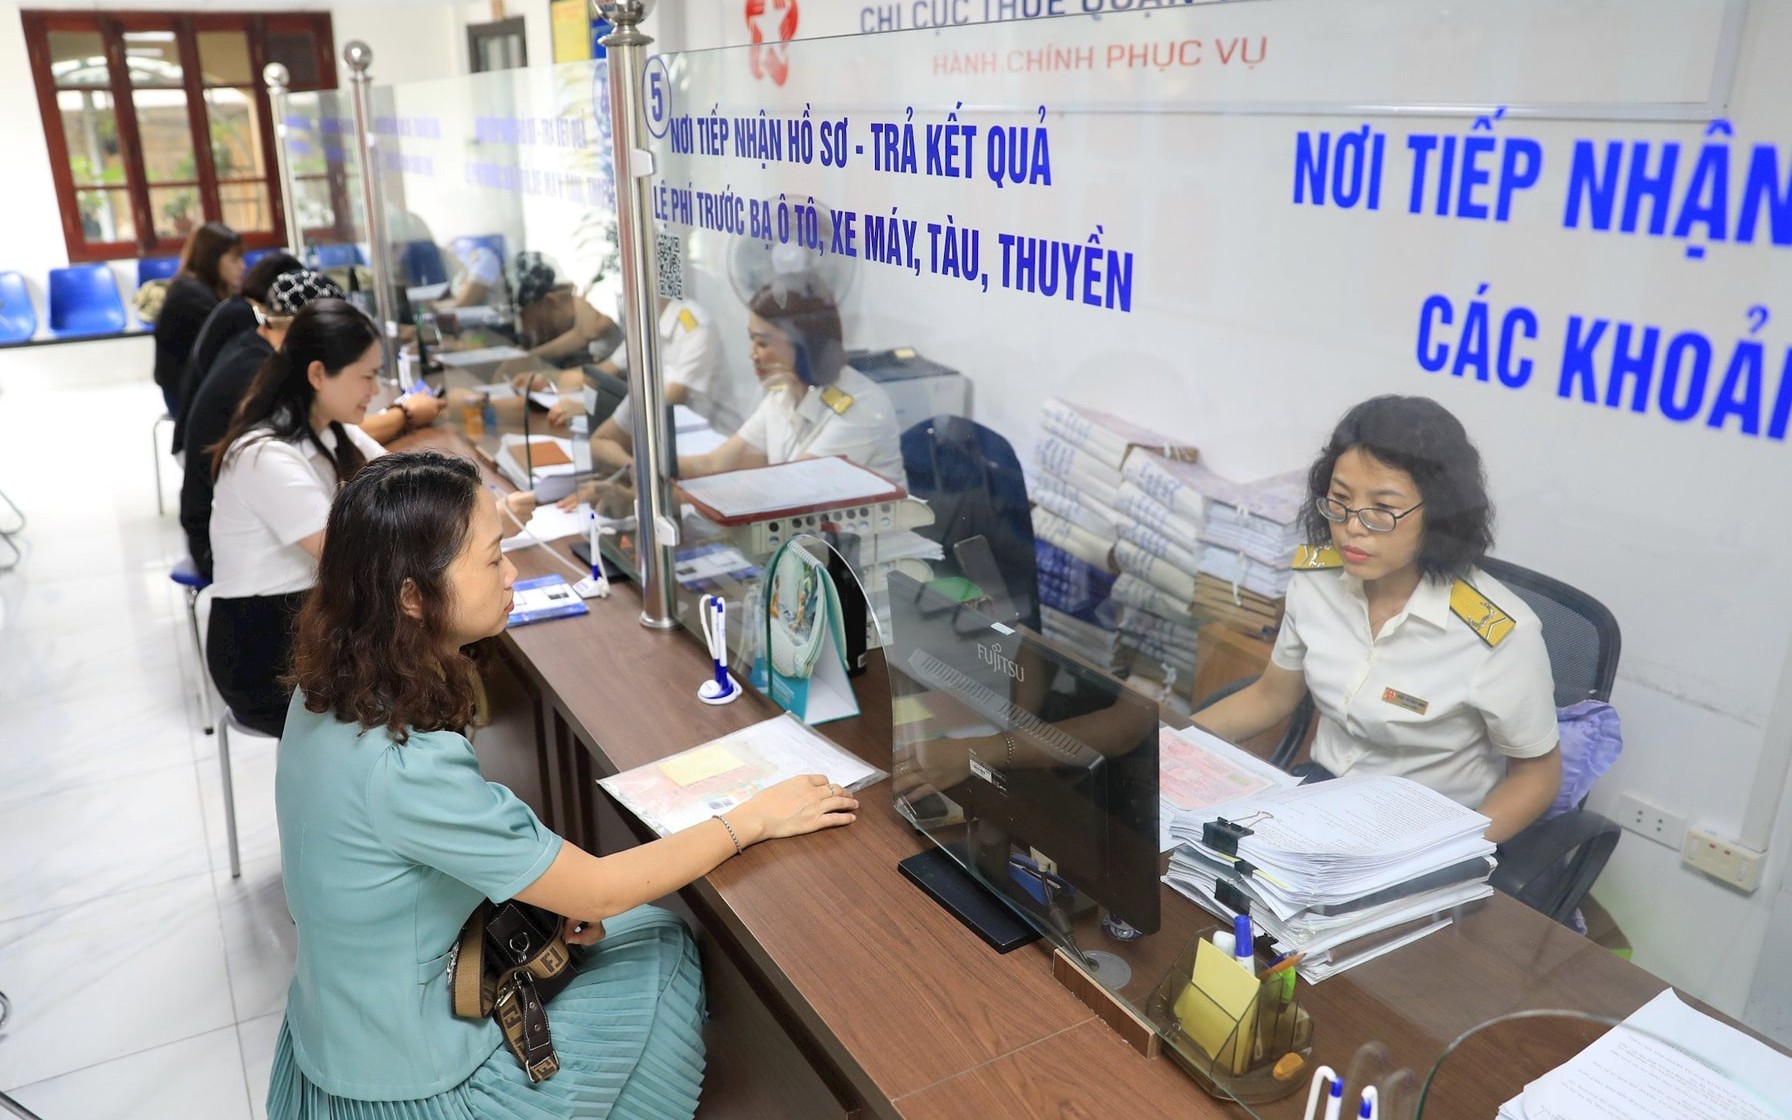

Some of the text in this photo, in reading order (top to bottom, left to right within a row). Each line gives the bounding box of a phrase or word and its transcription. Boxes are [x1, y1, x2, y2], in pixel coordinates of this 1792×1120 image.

[860, 5, 900, 34] CHI
[912, 0, 969, 36] CỤC
[1006, 43, 1094, 73] CHÍNH
[1106, 39, 1202, 72] PHỤC
[1215, 36, 1267, 70] VỤ
[650, 72, 663, 122] 5
[670, 114, 694, 154] NƠI
[697, 103, 729, 156] TIẾP
[733, 109, 782, 169] NHẬN
[787, 103, 813, 165] HỒ
[820, 117, 848, 168] SƠ
[870, 105, 918, 174] TRẢ
[926, 101, 977, 179] KẾT
[987, 105, 1052, 189] QUẢ
[1293, 106, 1792, 260] NƠI TIẾP NHẬN
[653, 179, 668, 229] LỆ
[671, 182, 693, 226] PHÍ
[696, 184, 745, 236] TRƯỚC
[749, 198, 773, 251] BẠ
[777, 193, 789, 244] Ô
[794, 196, 824, 257] TÔ,
[830, 209, 857, 258] XE
[864, 206, 920, 277] MÁY,
[927, 215, 988, 293] TÀU,
[998, 224, 1134, 314] THUYỀN
[1416, 283, 1539, 390] CÁC
[977, 643, 1025, 683] FUJITSU
